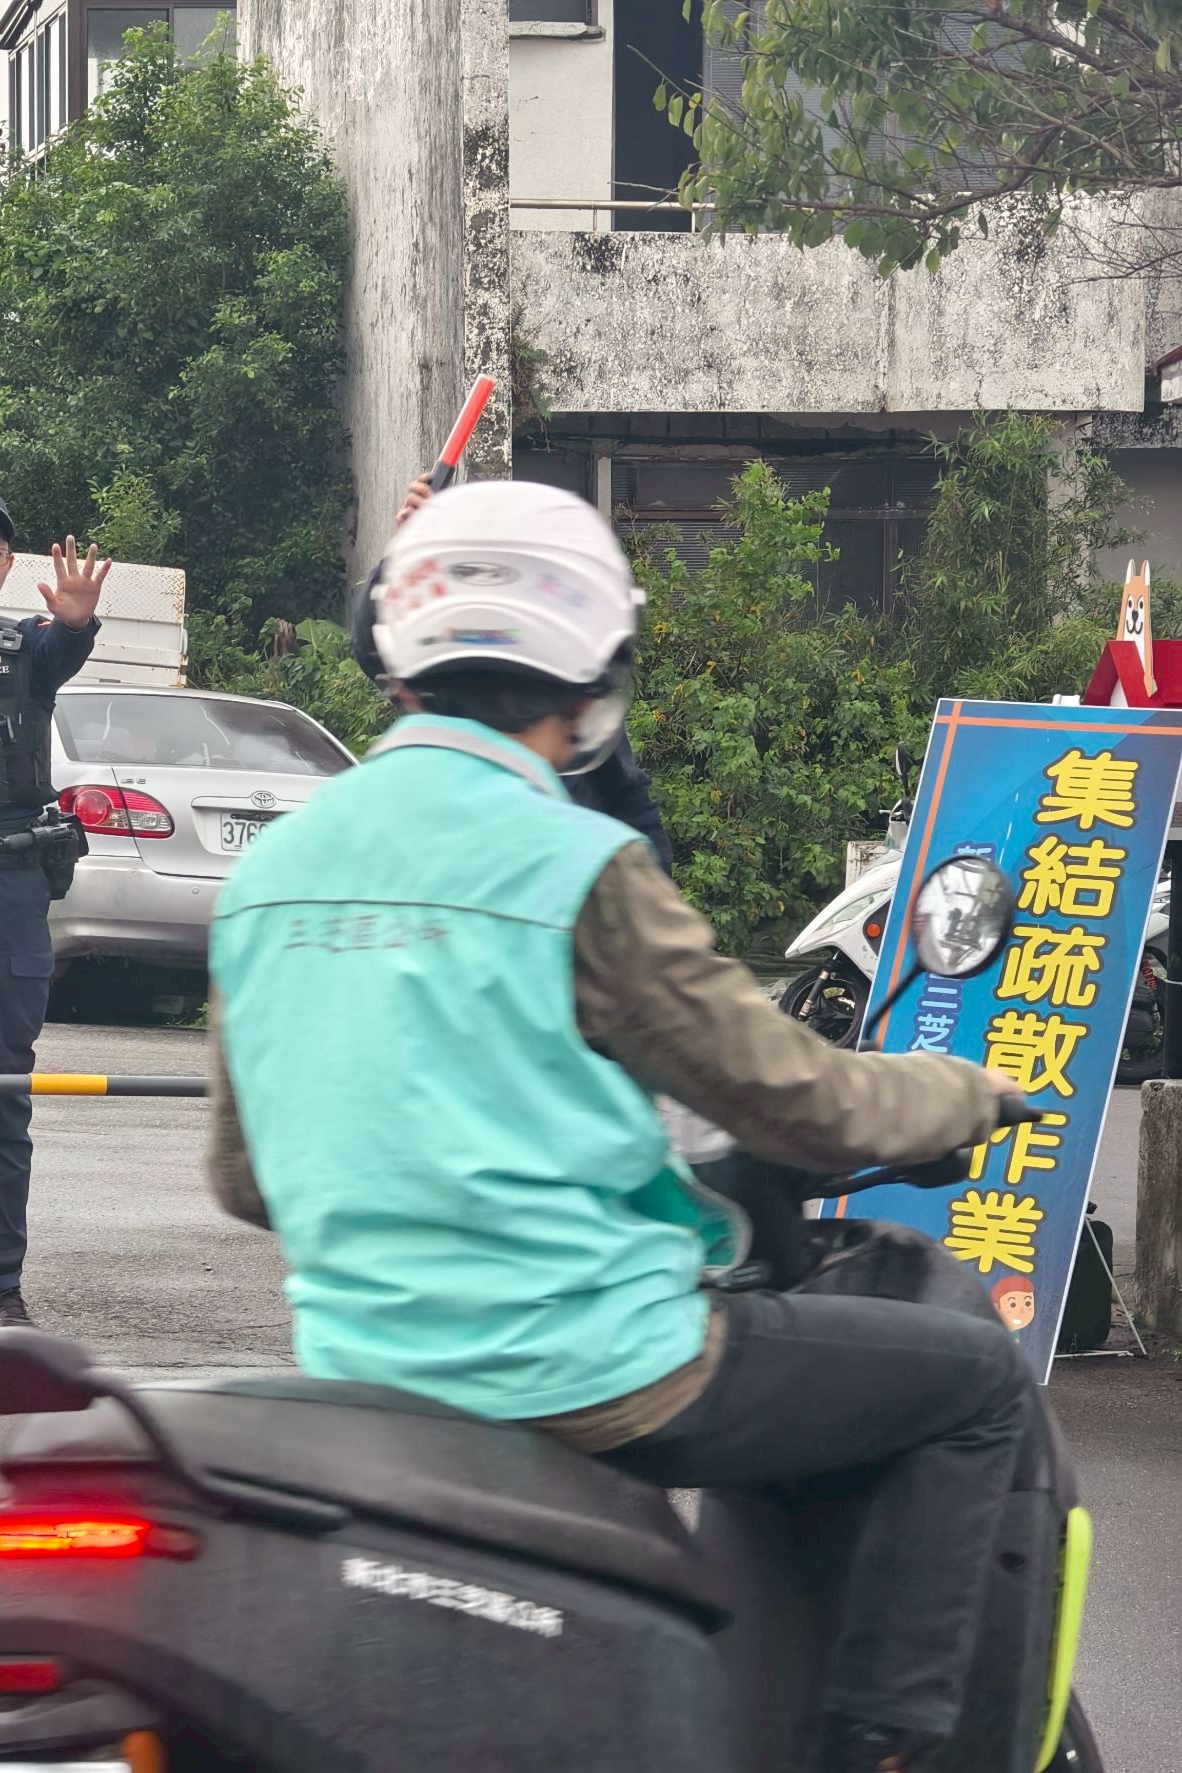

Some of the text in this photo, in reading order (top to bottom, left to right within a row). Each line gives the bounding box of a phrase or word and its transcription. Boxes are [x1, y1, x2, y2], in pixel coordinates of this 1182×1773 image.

[944, 750, 1137, 1273] 集結疏散作業
